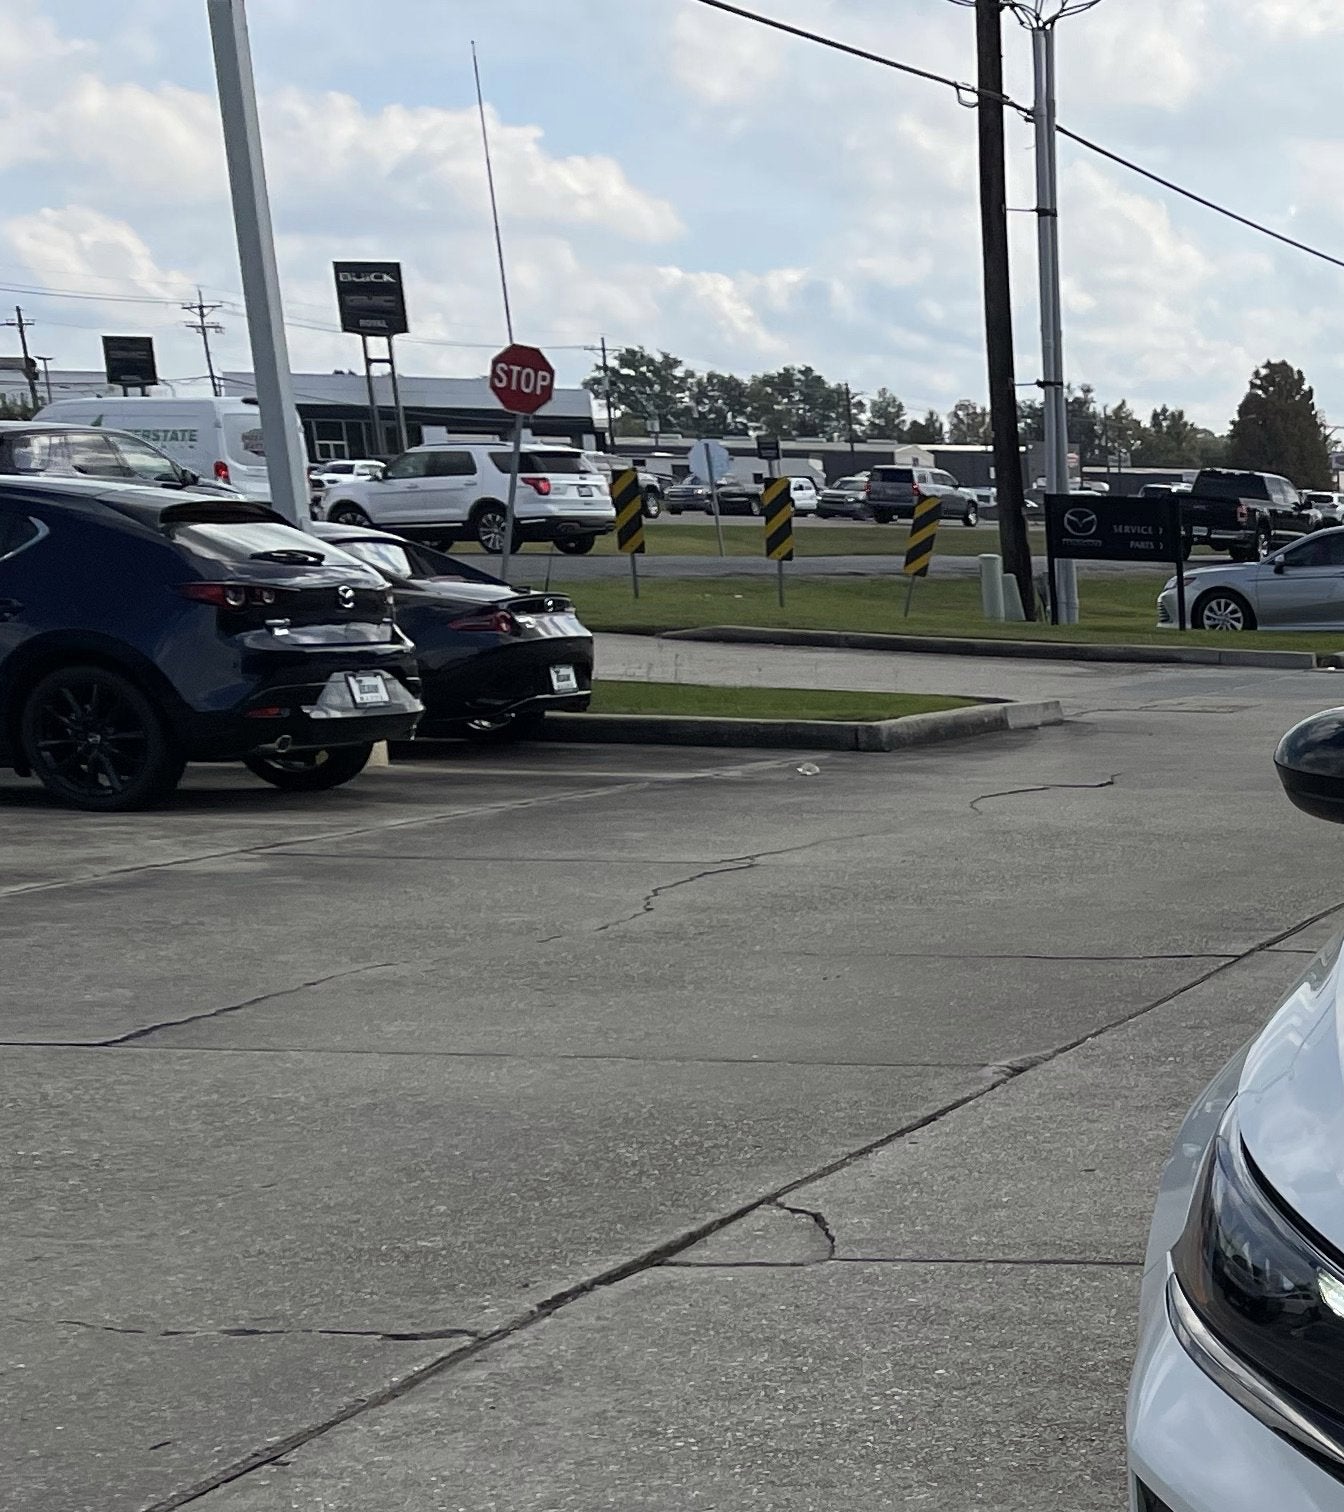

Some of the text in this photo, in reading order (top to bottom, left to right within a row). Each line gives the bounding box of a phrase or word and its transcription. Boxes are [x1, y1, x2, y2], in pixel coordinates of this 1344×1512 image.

[338, 272, 397, 283] BUICK
[494, 362, 551, 391] STOP
[1112, 525, 1153, 535] SERVICE
[1129, 540, 1155, 549] PARTS
